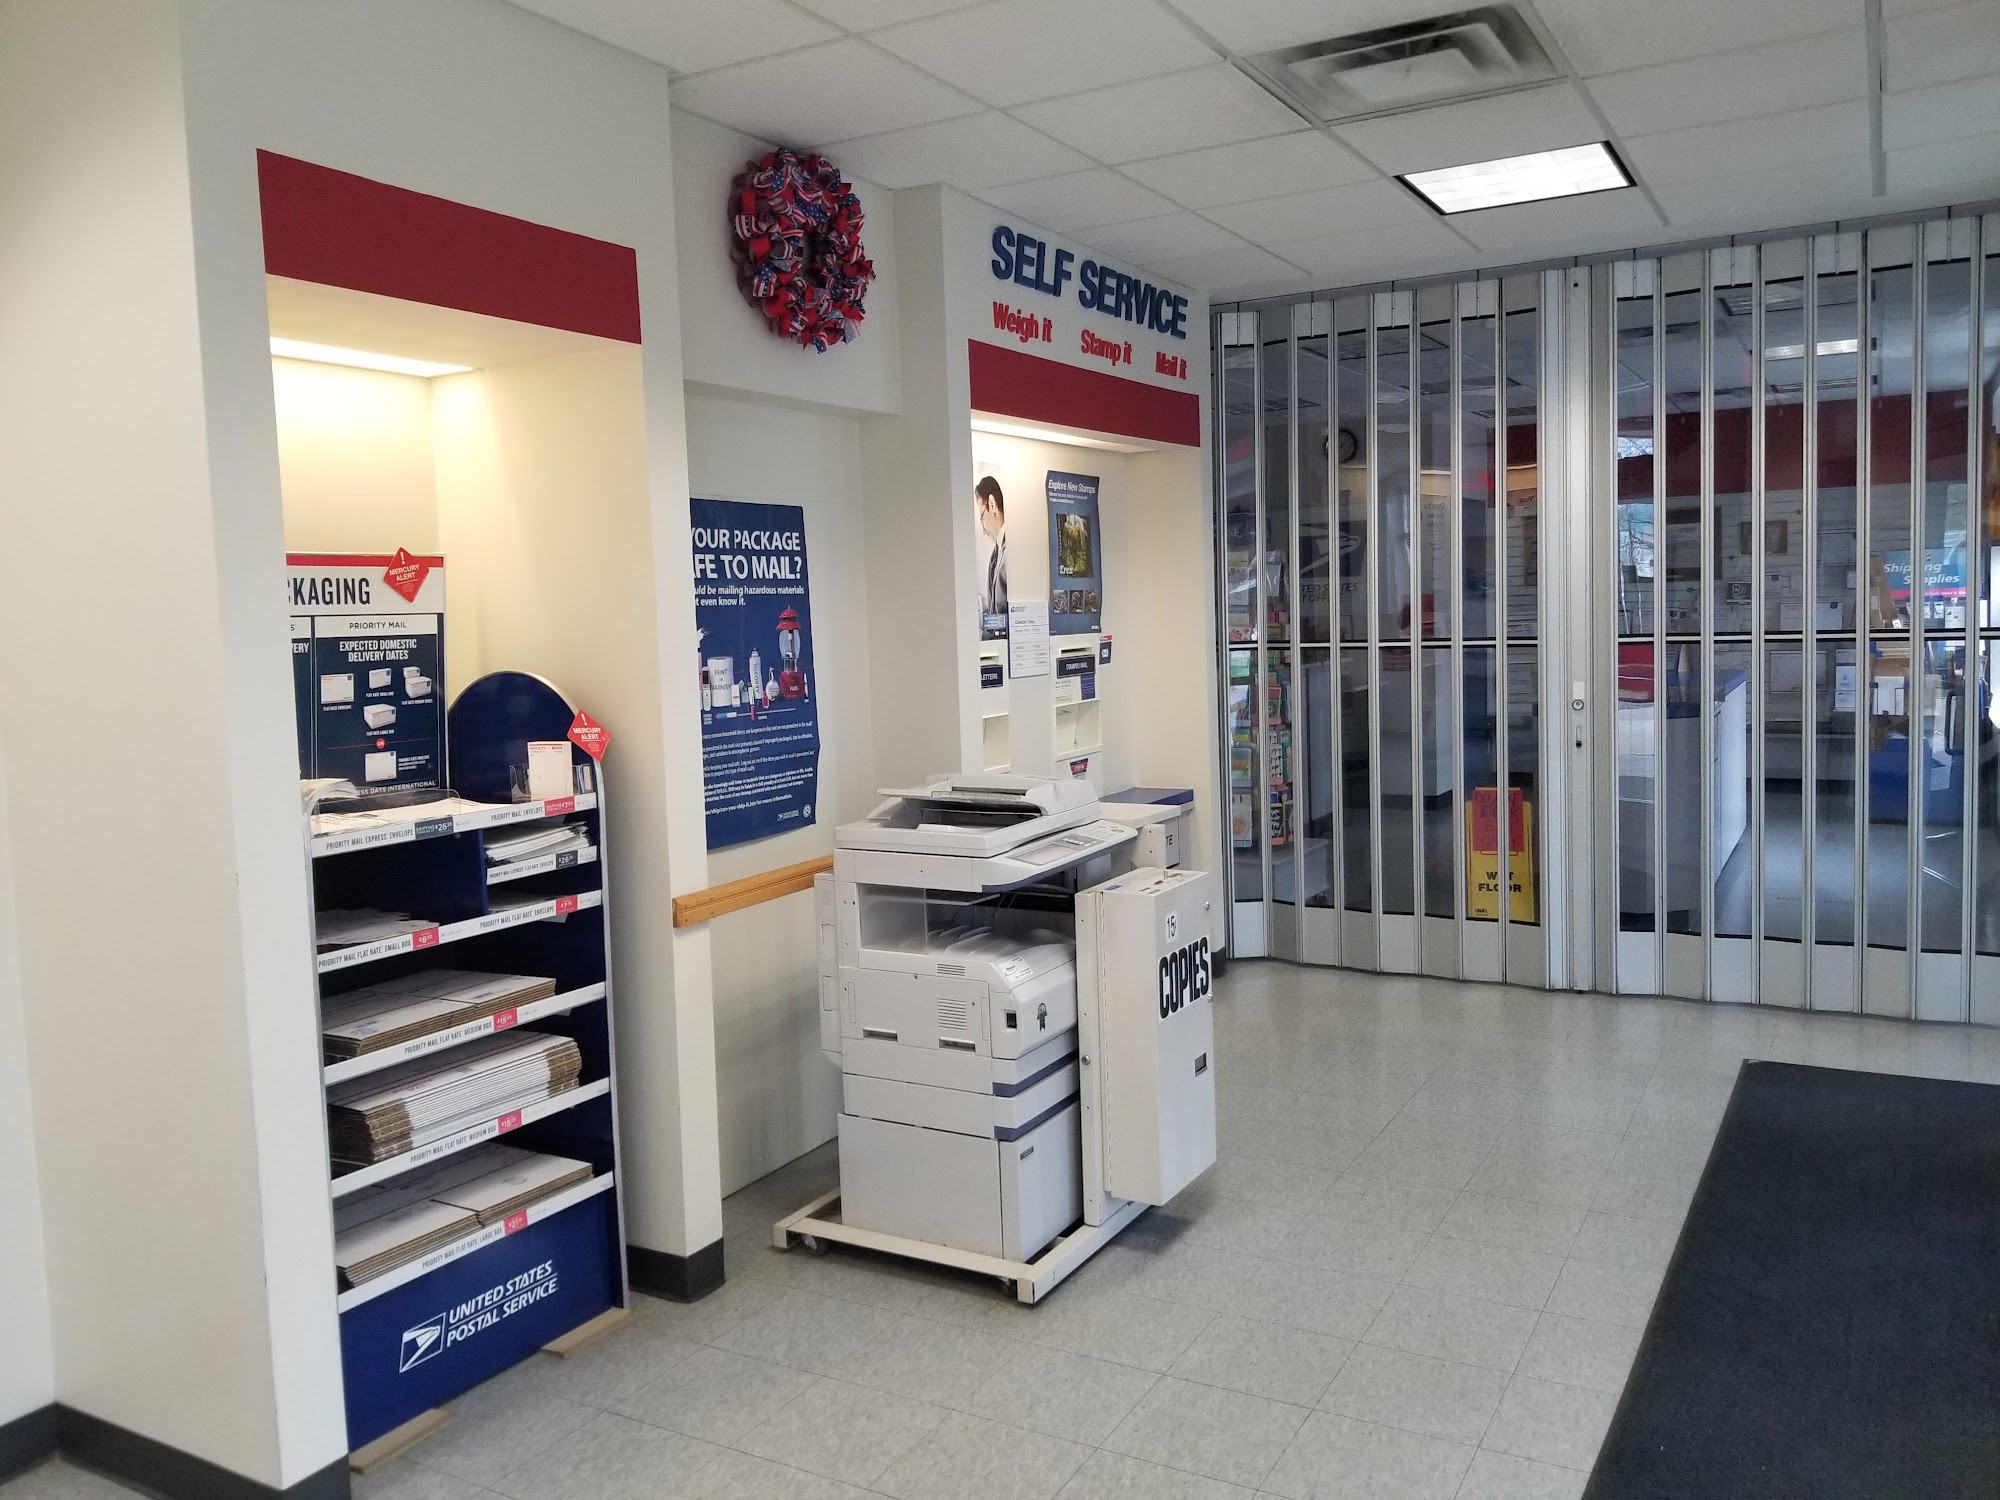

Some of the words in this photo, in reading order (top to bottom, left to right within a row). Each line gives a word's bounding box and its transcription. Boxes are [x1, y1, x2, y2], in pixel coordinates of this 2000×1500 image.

[991, 225, 1075, 297] SELF
[1078, 260, 1189, 340] SERVICE
[992, 301, 1039, 343] Weigh
[1042, 317, 1052, 342] it
[1080, 329, 1122, 366] Stamp
[1123, 341, 1133, 365] it
[1155, 351, 1178, 377] Mail
[1179, 358, 1187, 380] it
[1048, 479, 1066, 491] Explore
[1068, 482, 1078, 492] New
[1078, 483, 1096, 495] Stamps
[733, 529, 801, 551] PACKAGE
[389, 564, 420, 576] MERCURY
[396, 572, 416, 582] ALERT
[694, 553, 718, 579] FE
[719, 555, 749, 580] TO
[751, 555, 803, 580] MAIL?
[1884, 562, 1942, 574] Shipng
[694, 585, 706, 594] uld
[707, 585, 716, 594] be
[718, 585, 744, 596] mailing
[744, 585, 776, 594] hazardous
[778, 586, 804, 594] materials
[1323, 582, 1359, 592] STES
[1903, 574, 1960, 586] Splies
[718, 596, 738, 606] know
[340, 640, 378, 652] EXPECTED
[380, 639, 417, 650] DOMESTIC
[348, 652, 384, 662] DELIVERY
[386, 650, 409, 660] DATES
[387, 780, 436, 792] INTERNATIONAL
[491, 813, 510, 821] PRIORITY
[512, 810, 522, 818] MAIL
[523, 806, 543, 816] ENVELOPE
[326, 839, 350, 850] PRIORITY
[351, 837, 364, 845] MAIL
[365, 834, 387, 843] EXPRESS
[389, 829, 414, 840] ENVELOPE
[1165, 834, 1173, 847] TE
[1486, 871, 1514, 880] WT
[480, 918, 500, 928] PRIORITY
[512, 913, 521, 922] FLAT
[522, 911, 532, 920] RATE
[534, 905, 554, 916] ENVELOPE
[318, 956, 343, 968] PRIORITY
[343, 952, 356, 962] MAIL
[357, 950, 368, 959] FLAT
[369, 948, 382, 957] RATE
[384, 942, 400, 952] SMALL
[402, 940, 411, 948] BOX
[1159, 936, 1209, 1019] COPIES
[404, 1042, 427, 1055] PRIORITY
[427, 1037, 439, 1046] MAIL
[440, 1034, 450, 1043] FLAT
[451, 1030, 462, 1040] RATE
[464, 1024, 482, 1036] MEDIUM
[410, 1151, 432, 1163] PRIORITY
[433, 1146, 444, 1155] MAIL
[445, 1142, 455, 1150] FLAT
[456, 1137, 468, 1146] RATE
[469, 1130, 487, 1141] MEDIUM
[488, 1126, 496, 1134] BOX
[422, 1254, 444, 1269] PRIORITY
[444, 1249, 456, 1259] MAIL
[456, 1244, 466, 1254] FLAT
[480, 1232, 494, 1243] LARGE
[448, 1284, 505, 1324] UNITED
[506, 1259, 553, 1296] STATES
[446, 1309, 501, 1348] POSTAL
[502, 1277, 558, 1320] SERVICE
